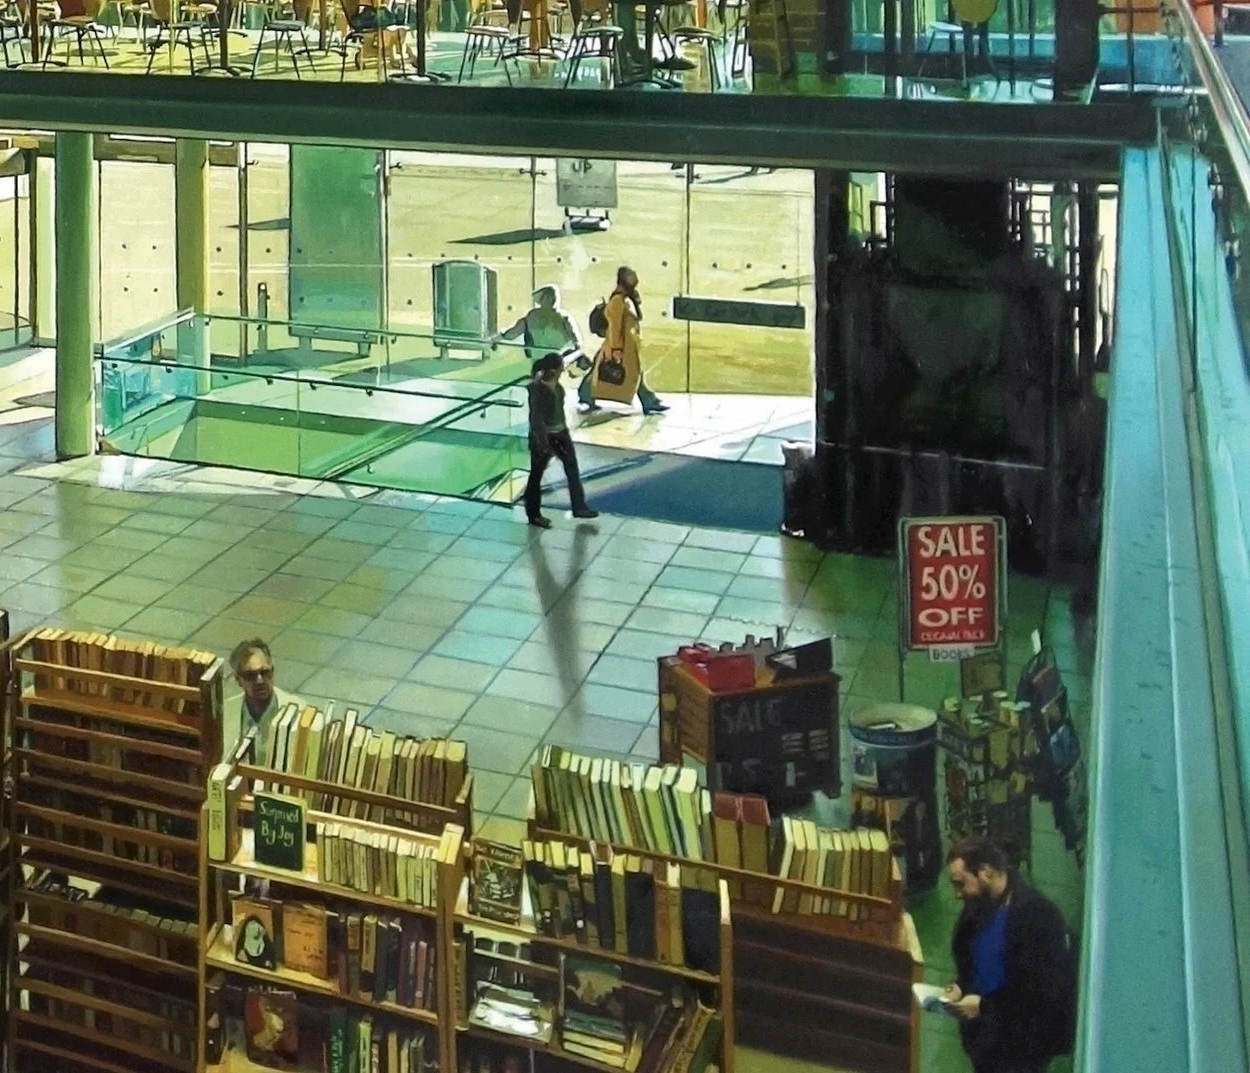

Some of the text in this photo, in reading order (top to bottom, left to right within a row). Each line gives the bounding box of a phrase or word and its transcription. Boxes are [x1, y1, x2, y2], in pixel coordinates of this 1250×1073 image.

[918, 525, 986, 558] SALE
[920, 563, 987, 602] 50%
[918, 607, 985, 628] OFF
[261, 819, 295, 848] By Joy
